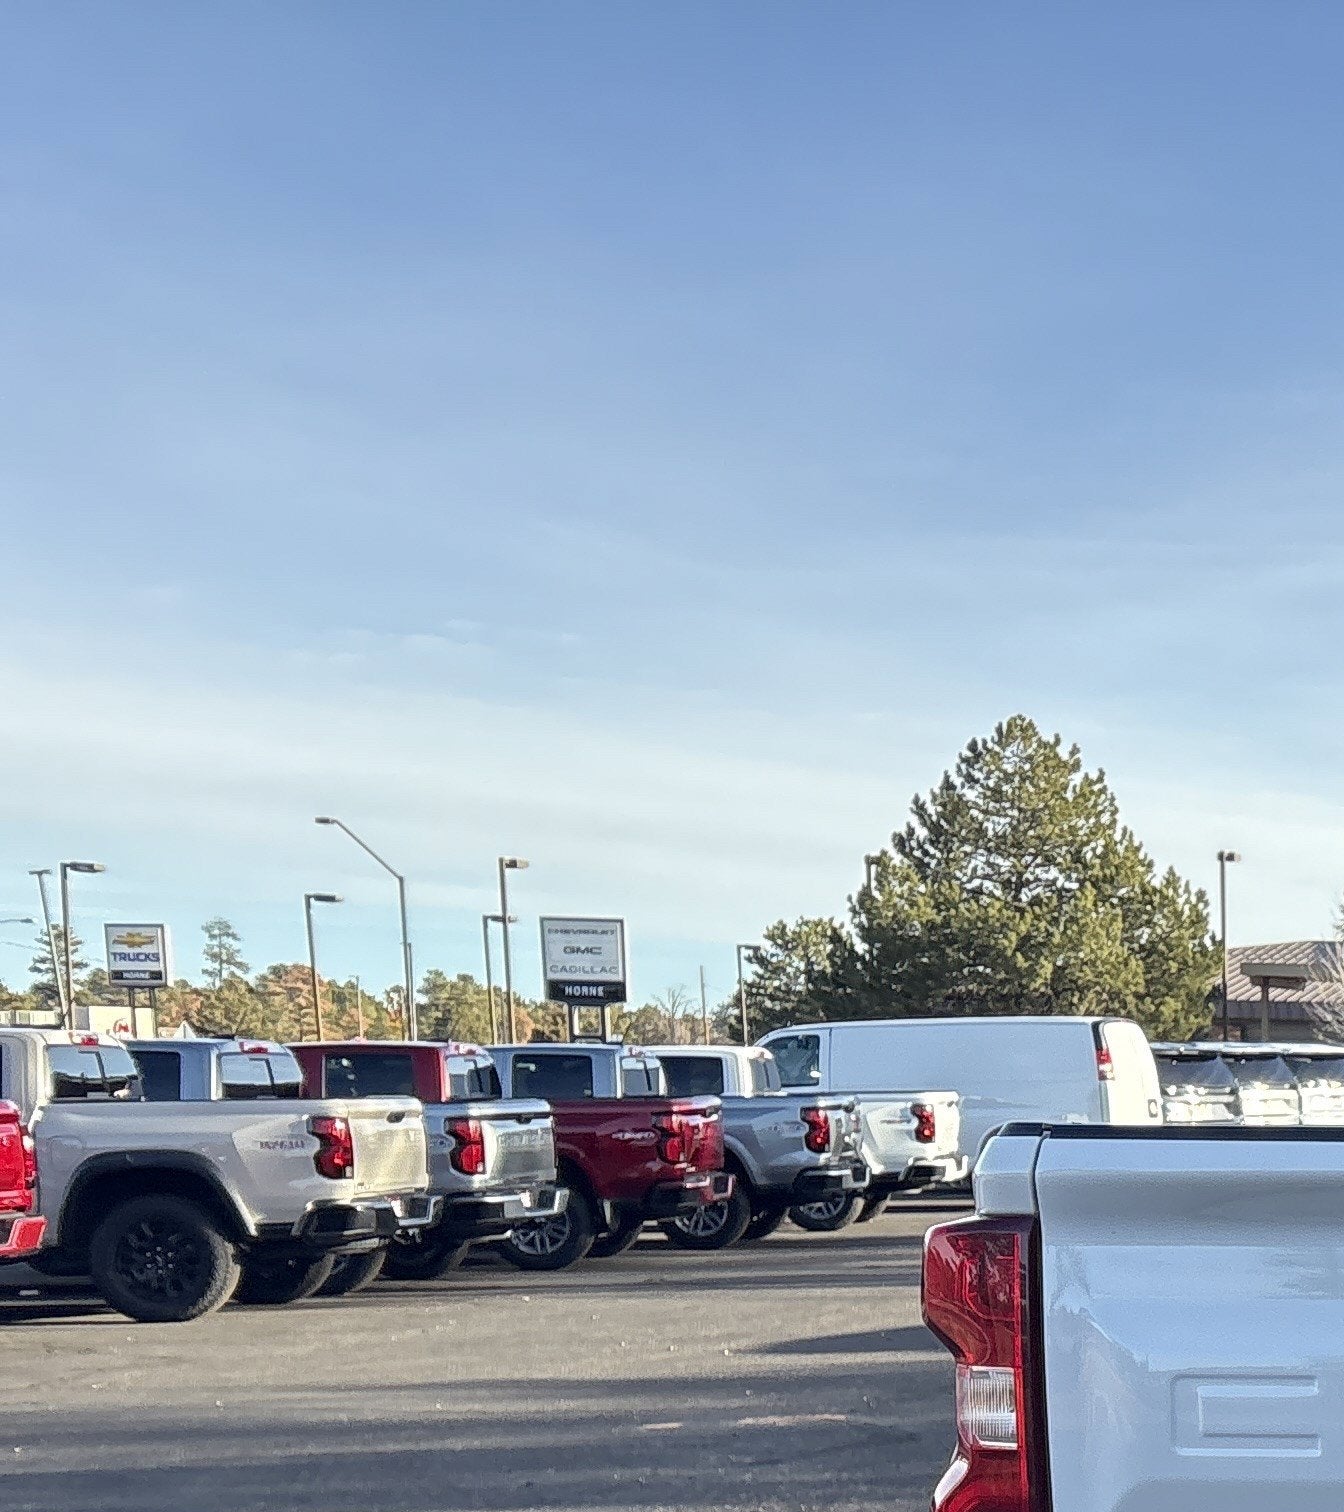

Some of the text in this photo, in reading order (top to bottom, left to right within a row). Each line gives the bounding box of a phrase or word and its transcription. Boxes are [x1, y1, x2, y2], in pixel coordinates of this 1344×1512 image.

[563, 946, 602, 955] GMC
[111, 952, 160, 962] TRUCKS
[549, 965, 618, 974] CADILLAC
[564, 986, 604, 997] HORNE
